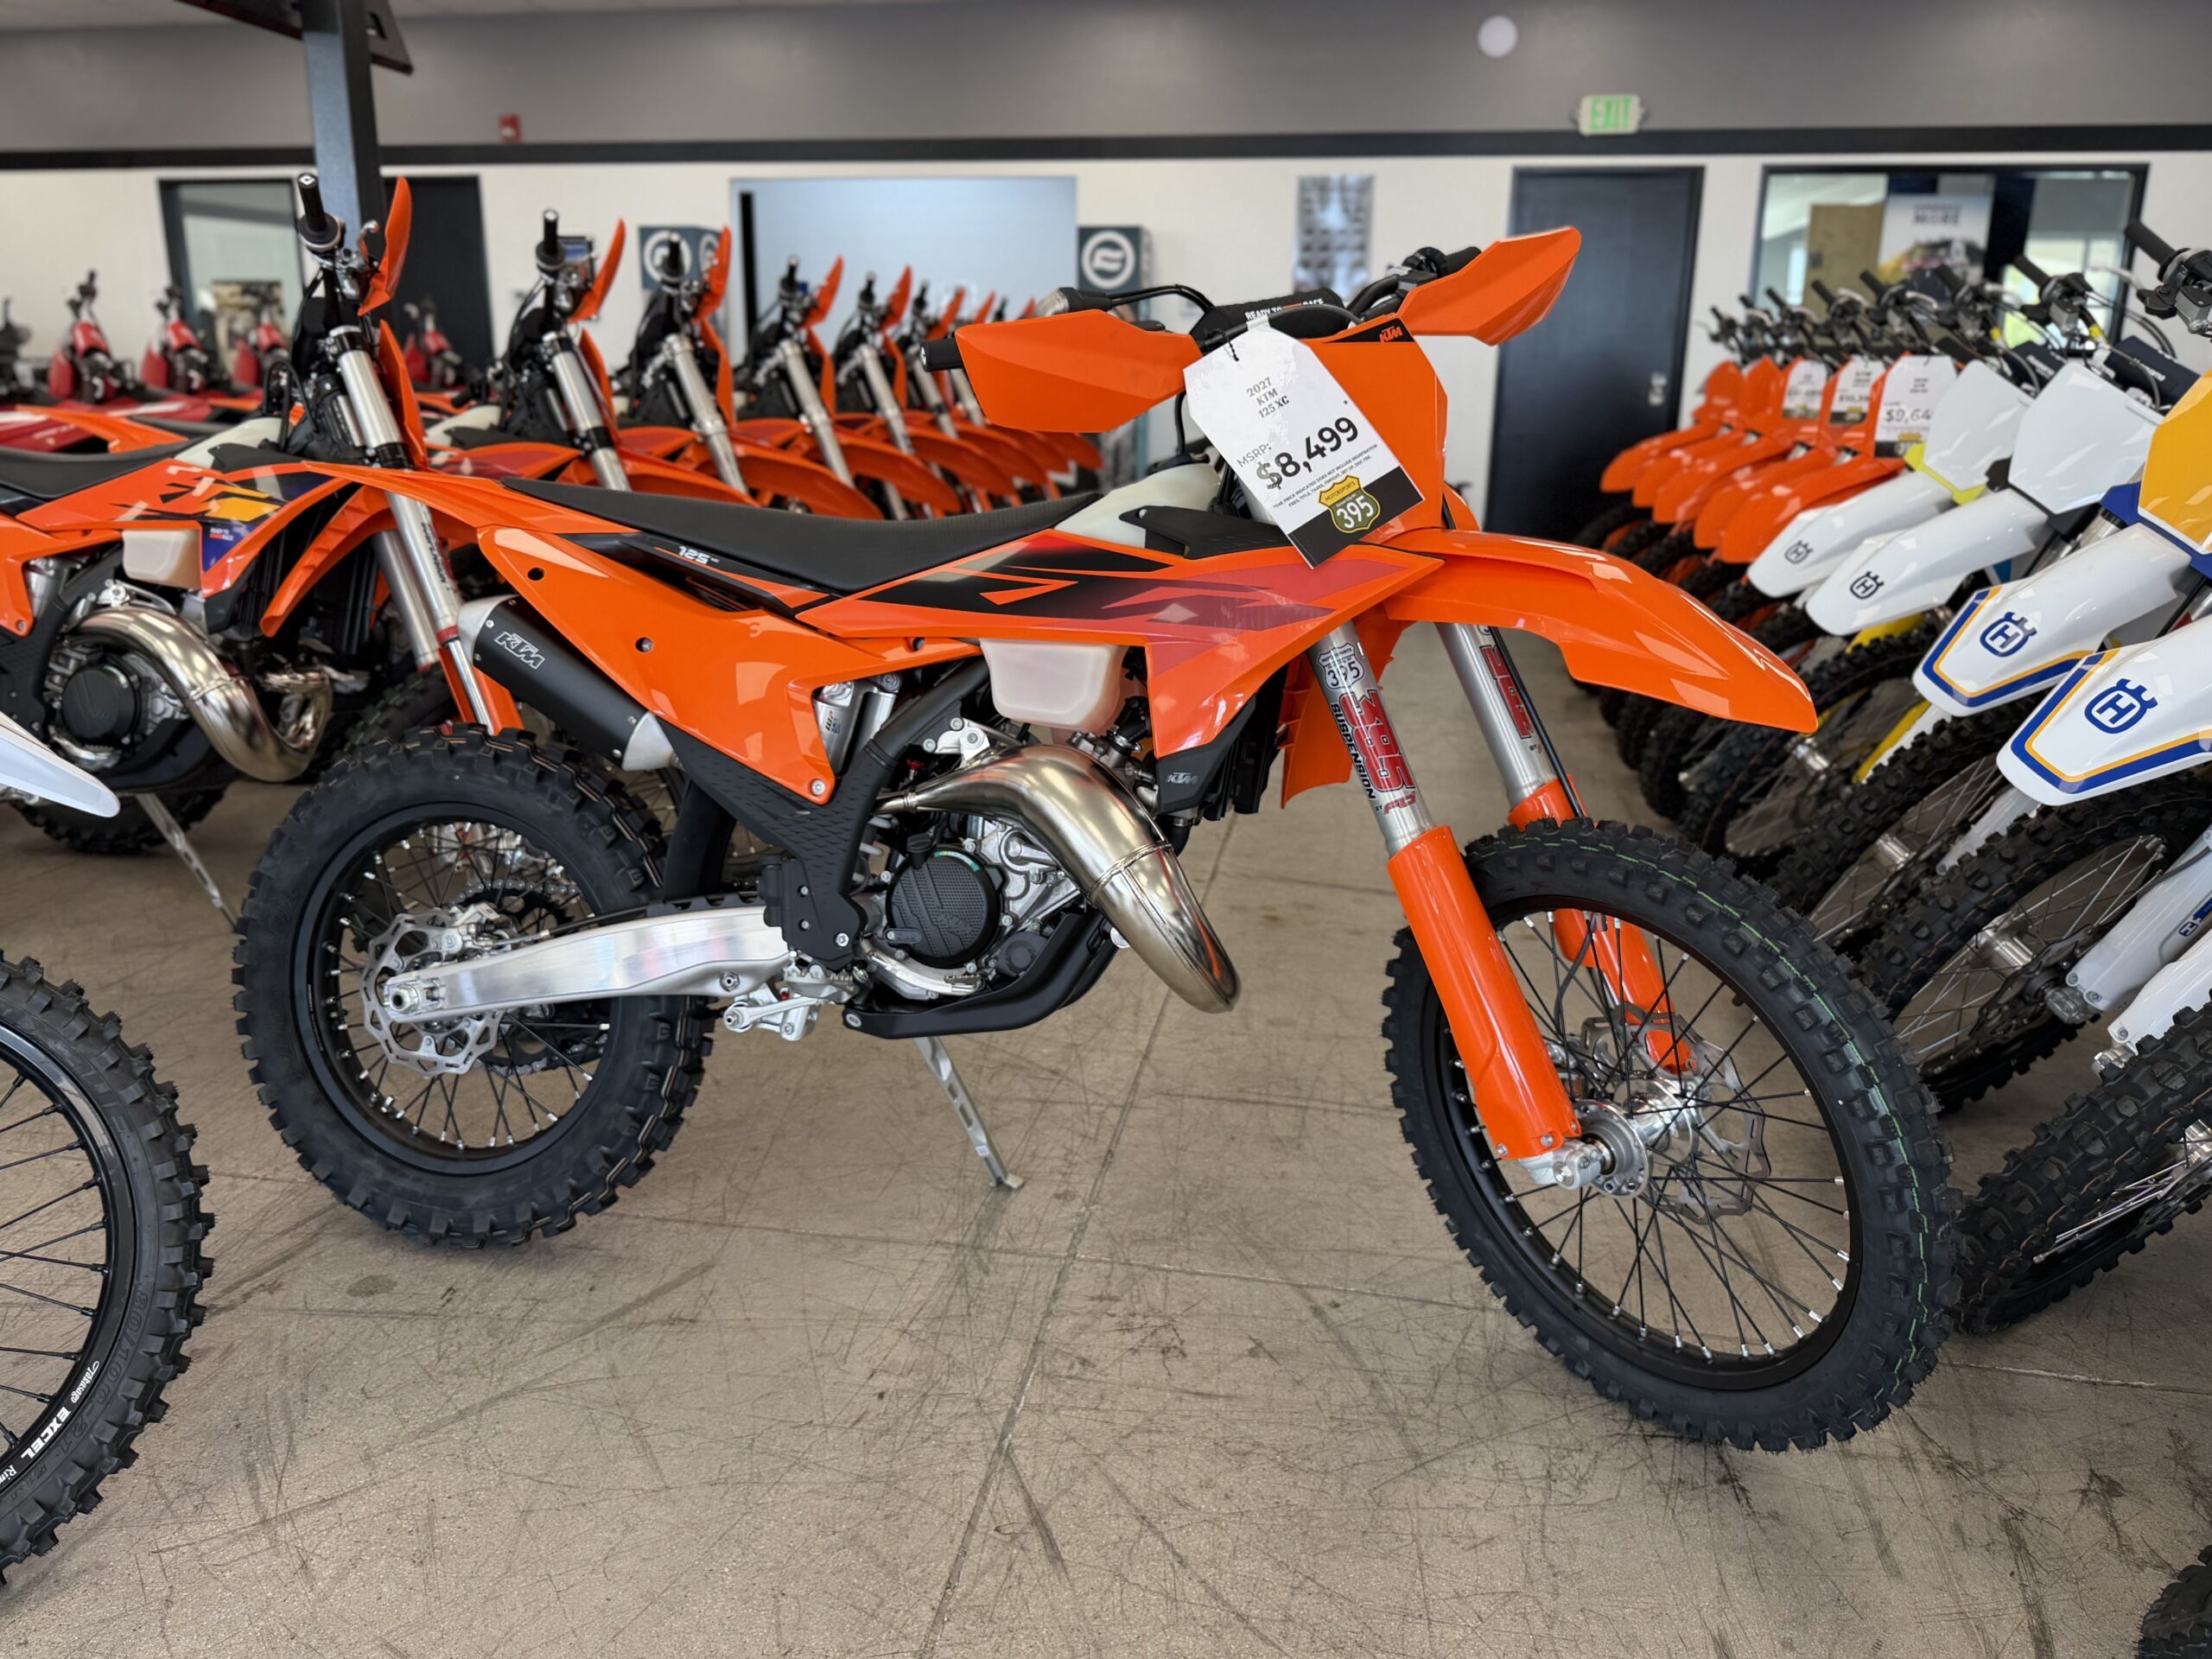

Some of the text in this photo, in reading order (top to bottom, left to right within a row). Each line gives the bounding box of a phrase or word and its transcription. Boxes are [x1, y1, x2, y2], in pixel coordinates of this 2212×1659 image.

[1591, 96, 1631, 130] EXIT
[1379, 326, 1403, 342] KTM
[1256, 388, 1278, 406] KTM
[1258, 395, 1289, 418] 125 XC
[1236, 442, 1272, 467] MSRP:
[1255, 416, 1358, 490] $8,499
[1283, 493, 1296, 503] PRICE
[1295, 480, 1317, 495] INDICATED
[1316, 474, 1328, 483] DOES
[1335, 459, 1352, 471] INCLUDE
[1325, 480, 1356, 501] MOTORSPORTS
[1337, 495, 1374, 528] 395
[678, 545, 710, 565] 125
[494, 631, 545, 670] KTM
[1330, 702, 1376, 799] SUSPENSION
[1339, 690, 1415, 791] 395
[71, 1360, 100, 1403] Takasago
[21, 1406, 72, 1459] EXCEL
